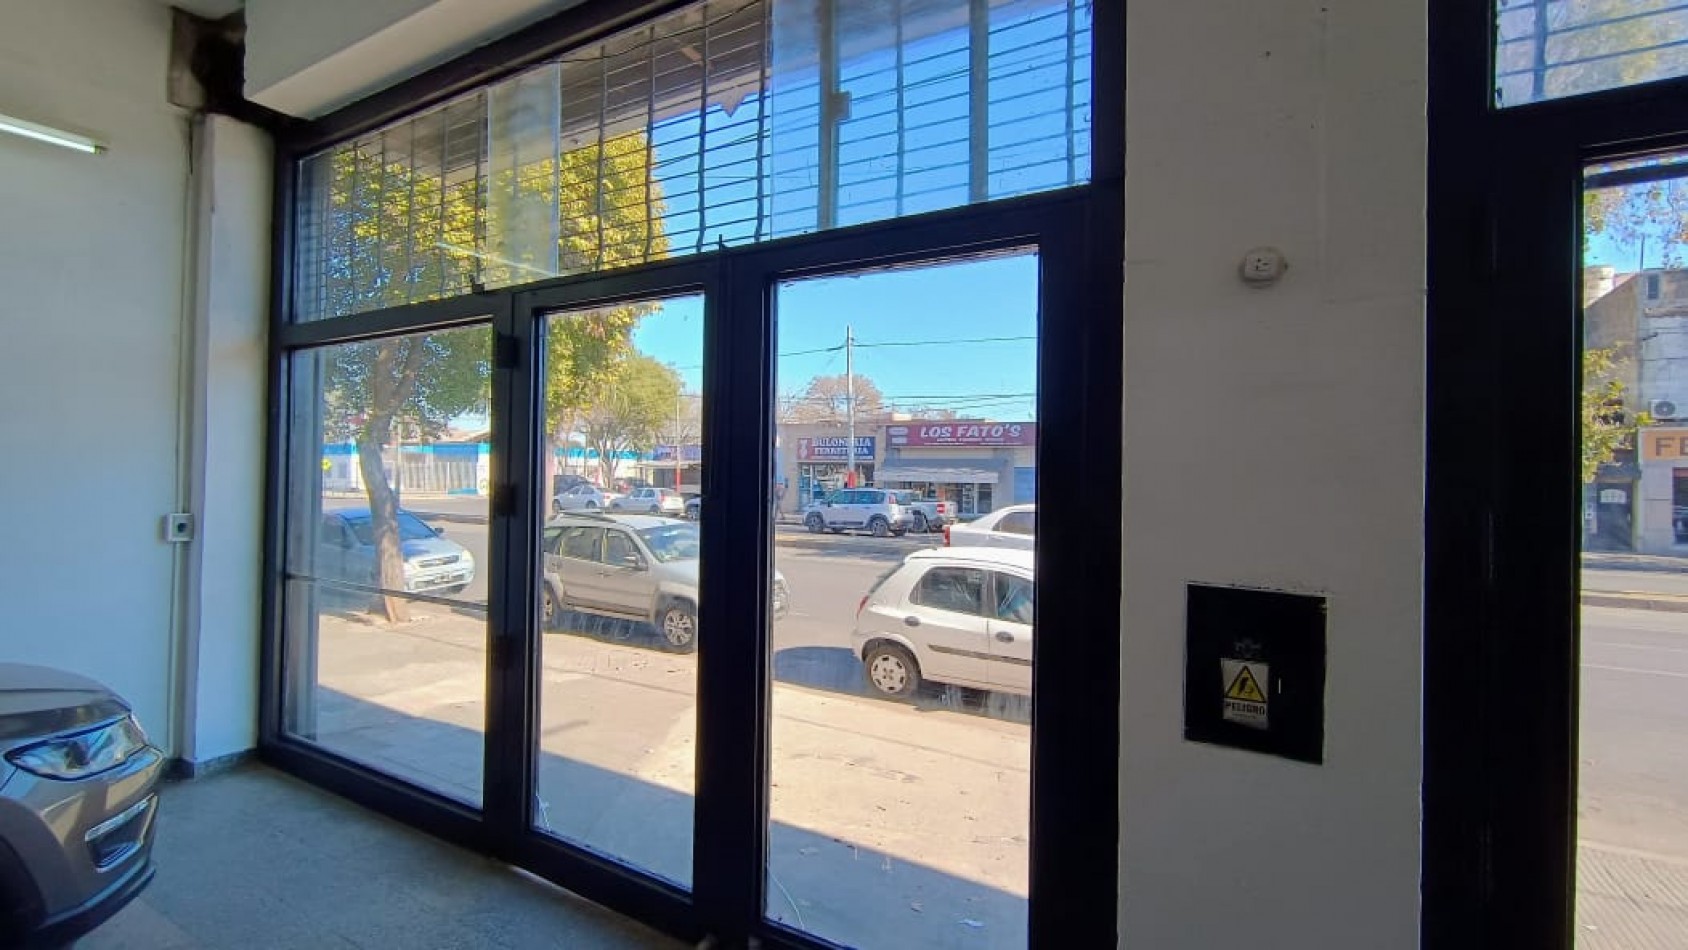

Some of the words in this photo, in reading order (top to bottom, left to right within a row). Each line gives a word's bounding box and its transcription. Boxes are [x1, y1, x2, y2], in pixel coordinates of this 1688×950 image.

[921, 426, 952, 437] LOS
[957, 424, 1021, 437] FATO'S
[811, 437, 871, 447] BULONRIA
[814, 447, 869, 455] FERRETRIA
[1225, 700, 1265, 716] PELIGRO
